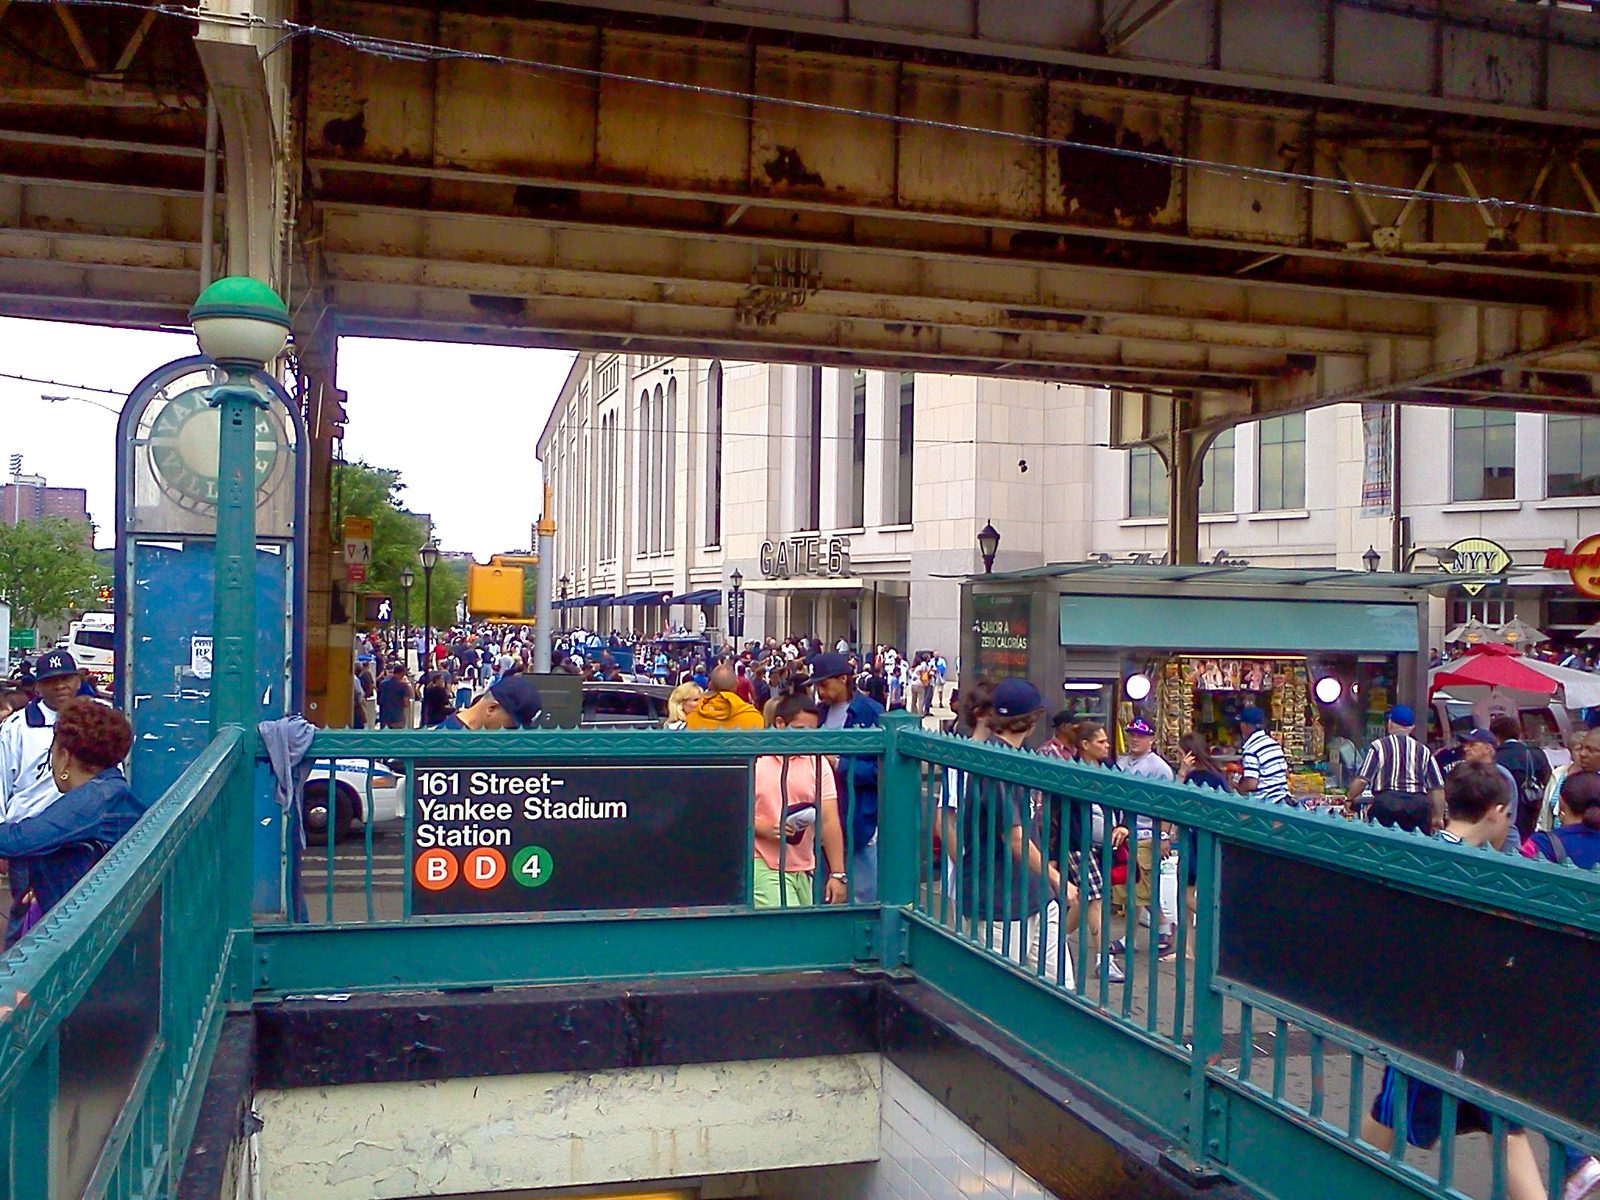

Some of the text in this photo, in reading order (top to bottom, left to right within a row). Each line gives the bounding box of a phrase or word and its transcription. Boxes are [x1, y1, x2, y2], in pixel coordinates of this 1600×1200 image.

[760, 538, 843, 576] GATE 6
[1452, 551, 1498, 571] NYY
[981, 620, 1003, 634] SABOR
[1004, 621, 1010, 634] A
[981, 634, 1027, 649] ZERO CALORÍAS
[417, 771, 565, 795] 161 Street-
[417, 796, 627, 821] Yankee Stadium
[416, 823, 511, 847] Station
[426, 854, 541, 881] B D 4
